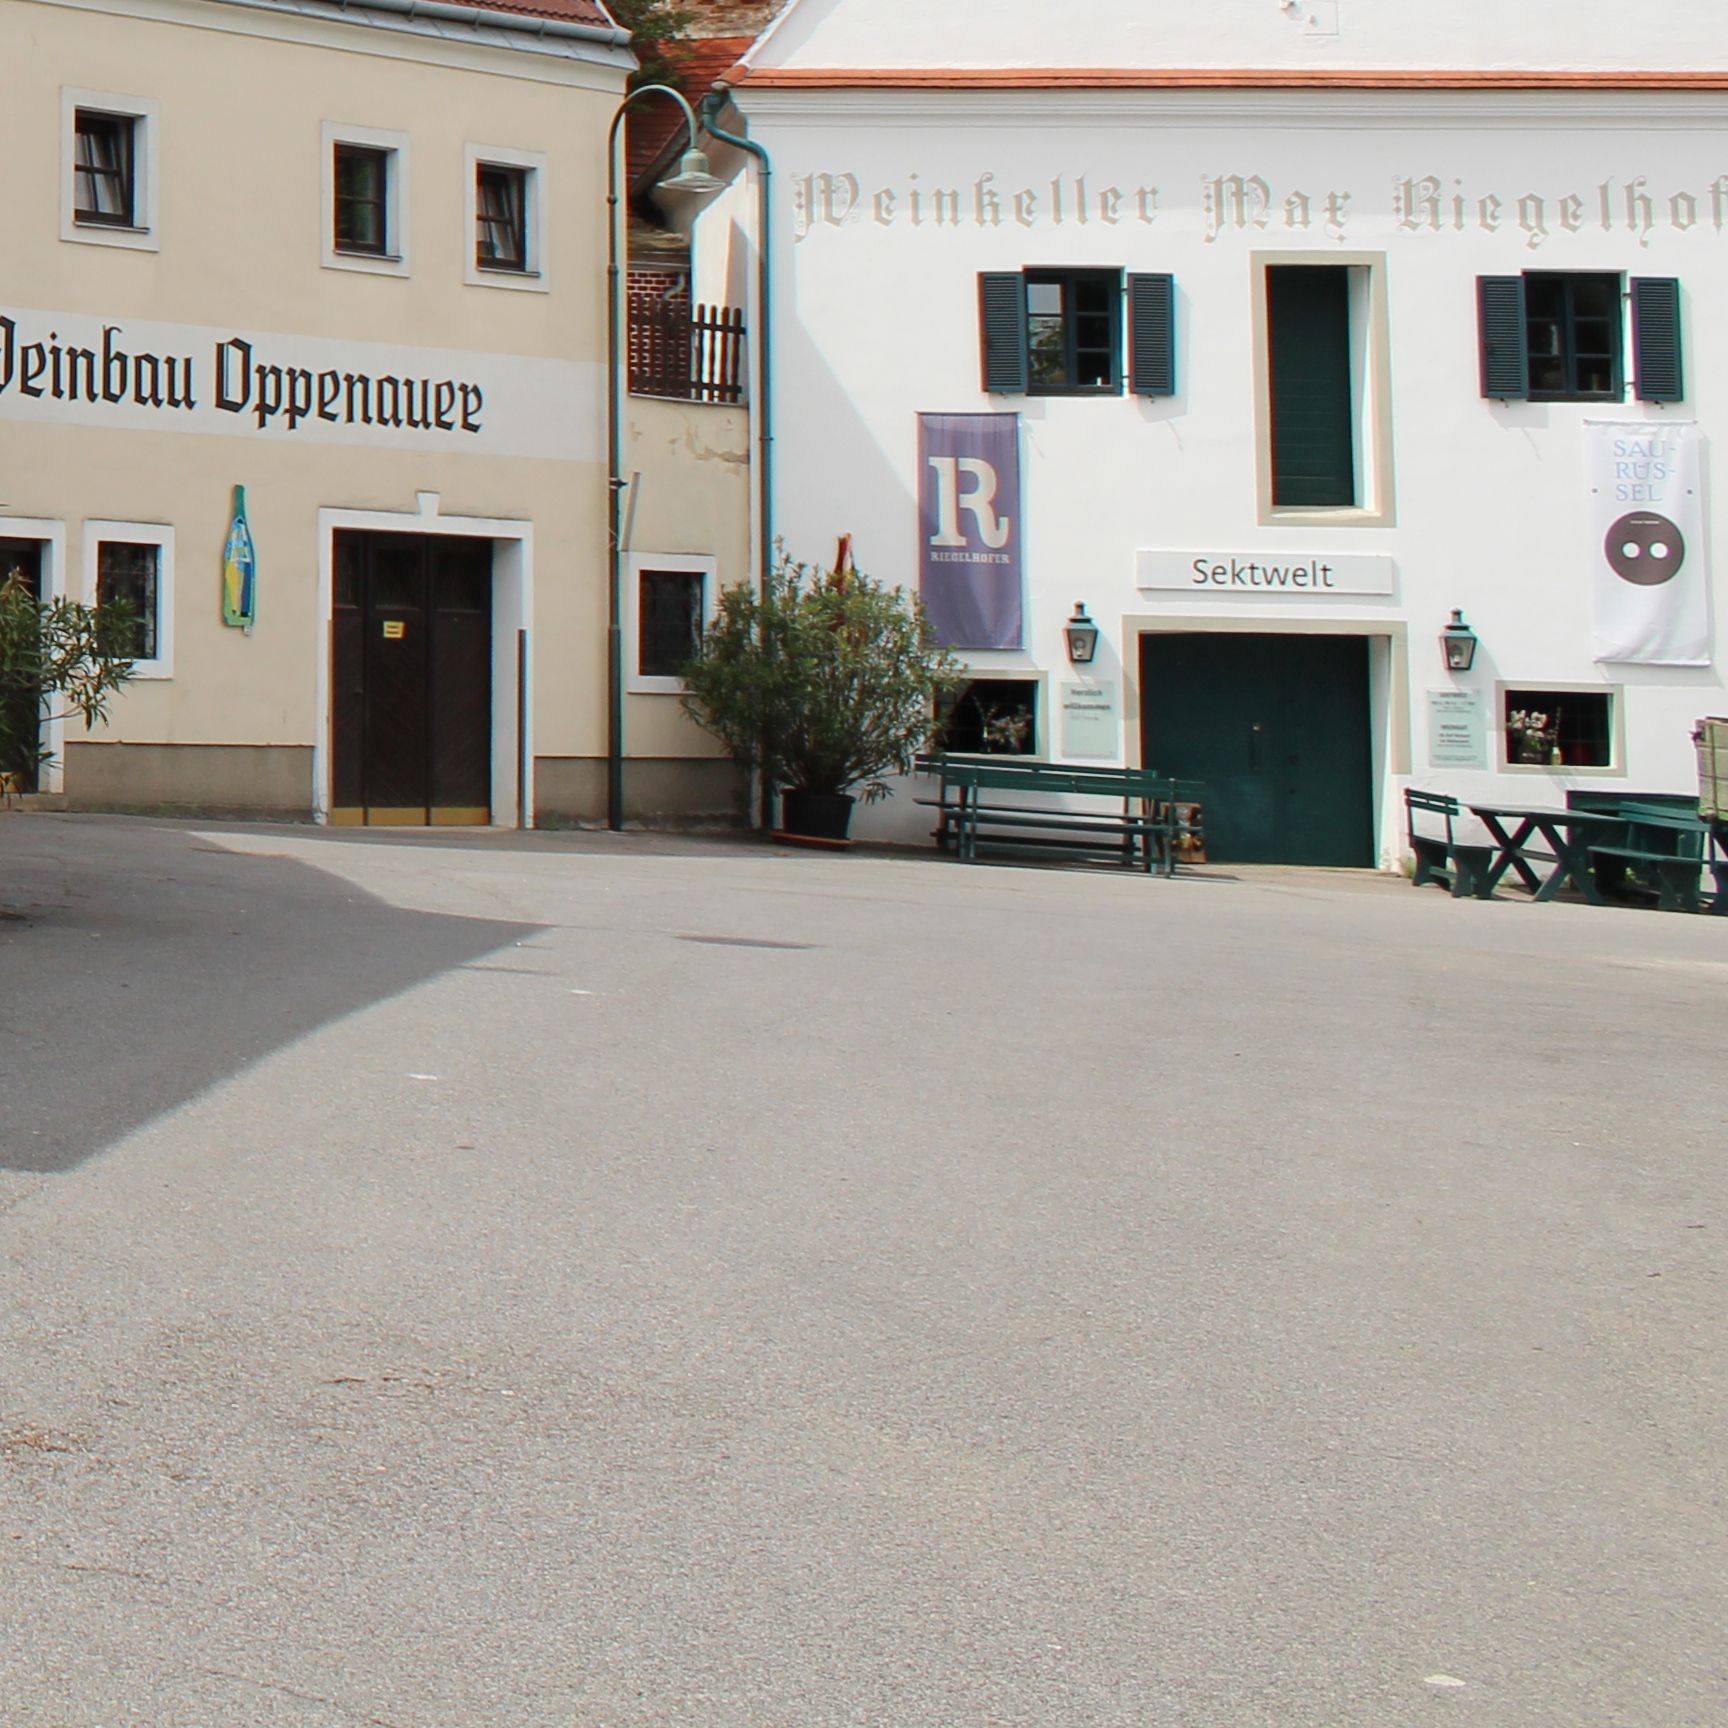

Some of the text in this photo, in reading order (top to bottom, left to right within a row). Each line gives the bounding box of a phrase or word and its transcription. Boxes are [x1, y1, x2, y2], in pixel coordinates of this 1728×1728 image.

[793, 171, 1160, 244] Weinkeller
[1199, 171, 1353, 244] Max
[214, 336, 484, 432] Oppenauer
[1613, 439, 1676, 458] SAU-
[928, 456, 1010, 549] R
[1615, 483, 1663, 502] SEL
[930, 551, 1010, 564] RIEGELHOFER
[1192, 558, 1335, 587] Sektwelt
